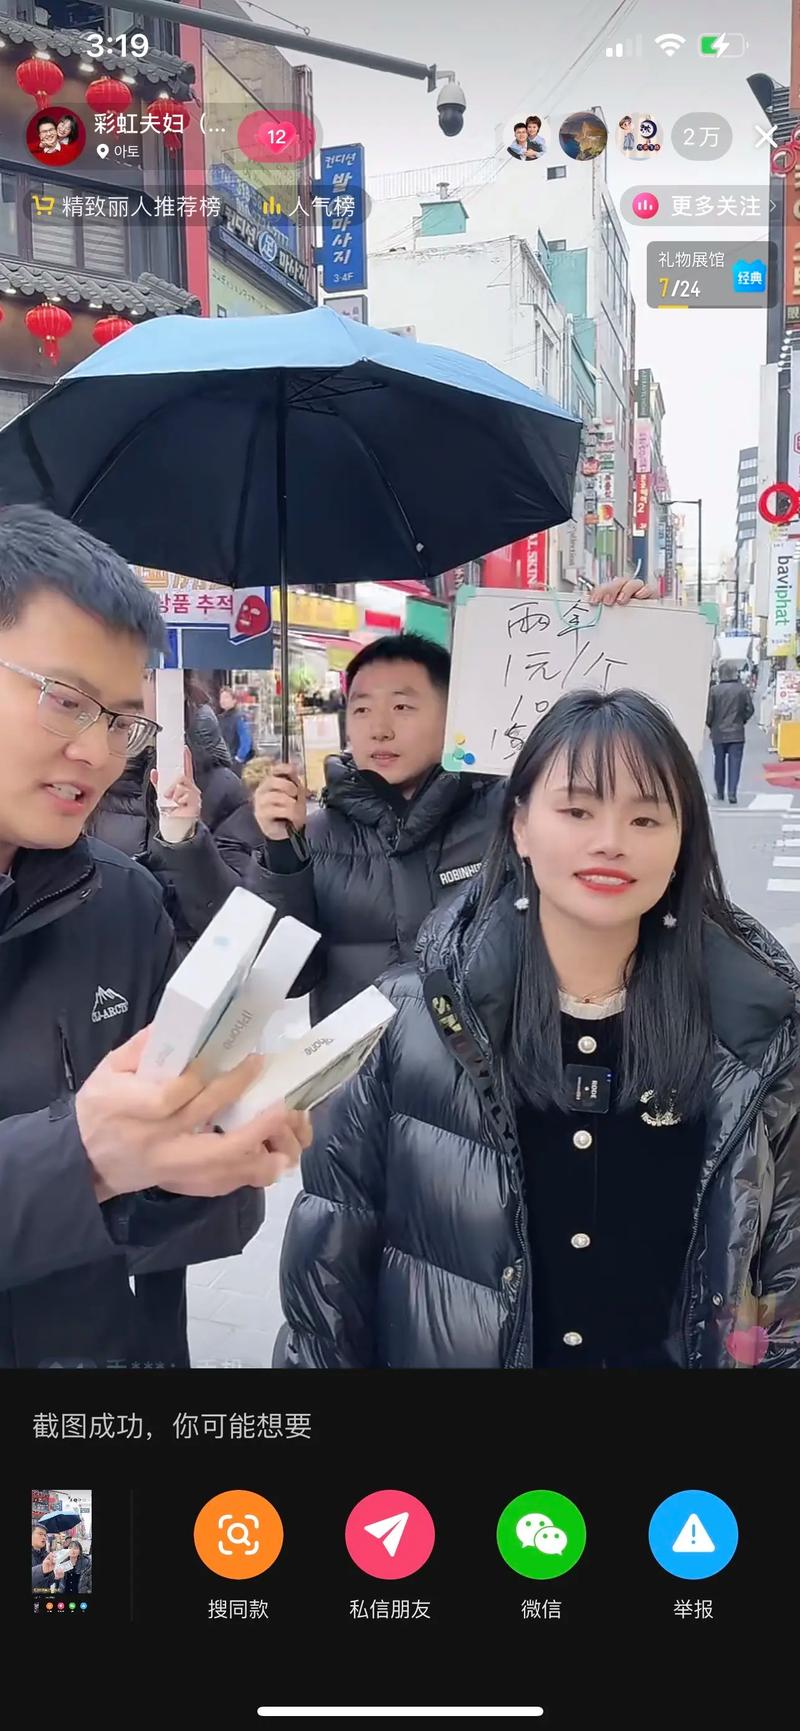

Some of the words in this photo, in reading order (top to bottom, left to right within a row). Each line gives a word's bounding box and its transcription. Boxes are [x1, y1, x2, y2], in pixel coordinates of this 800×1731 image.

[325, 153, 356, 168] 컨디션
[527, 552, 538, 585] SKIN
[196, 594, 234, 615] 추적
[774, 555, 793, 627] baviphat
